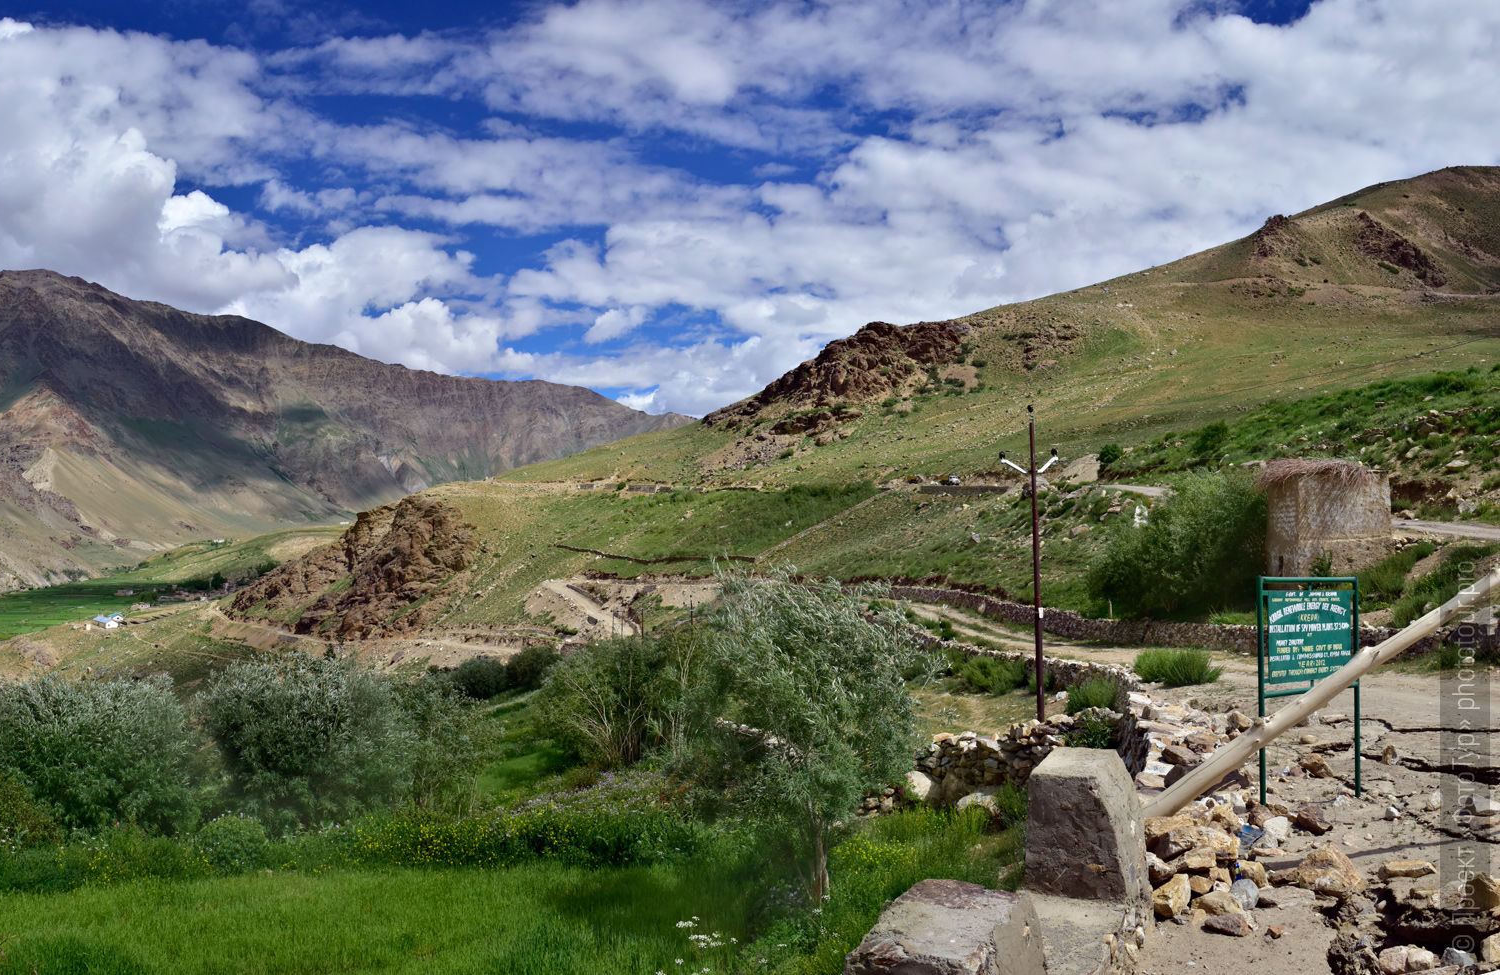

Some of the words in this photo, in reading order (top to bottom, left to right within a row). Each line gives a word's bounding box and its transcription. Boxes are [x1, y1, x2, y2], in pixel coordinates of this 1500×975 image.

[1306, 602, 1321, 610] ENERGY
[1329, 603, 1347, 616] AGENCY
[1269, 624, 1295, 633] INSTALLATION
[1308, 623, 1321, 632] POWER
